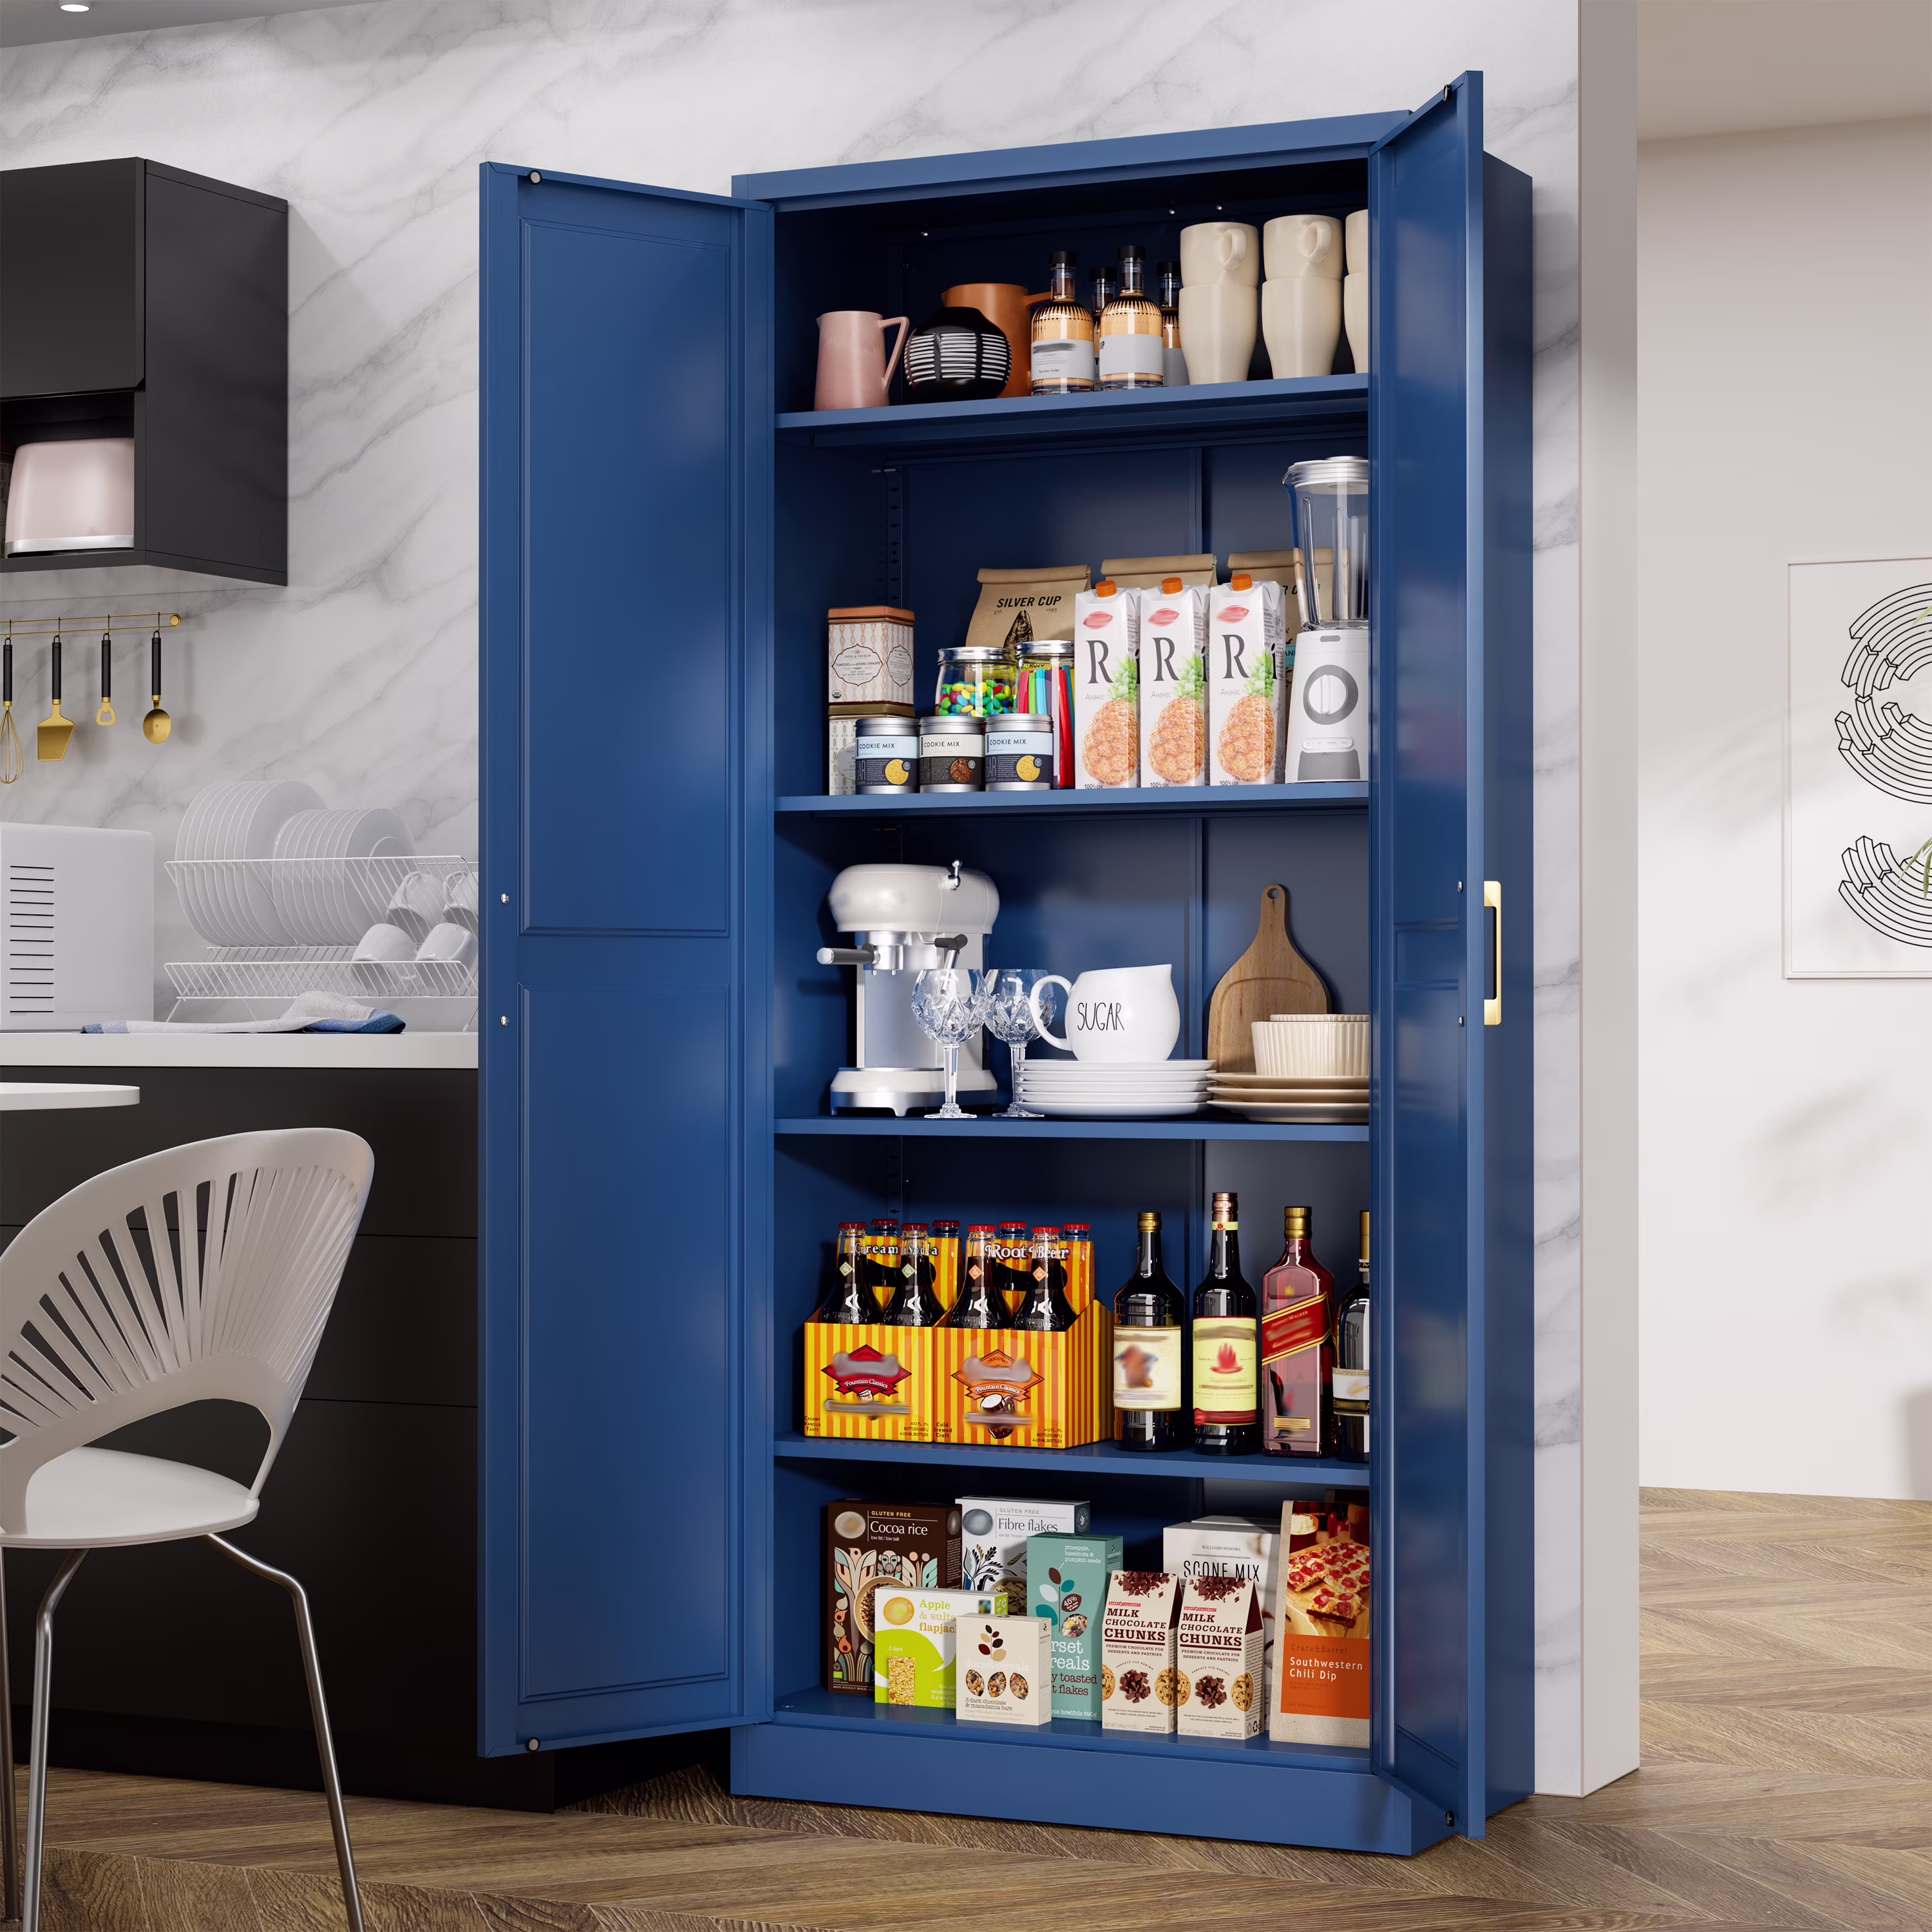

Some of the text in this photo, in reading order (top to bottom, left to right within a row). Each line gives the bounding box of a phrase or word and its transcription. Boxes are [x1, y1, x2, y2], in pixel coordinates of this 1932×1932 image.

[997, 596, 1061, 608] SILVER CUP
[1077, 1002, 1124, 1030] SUGAR
[984, 1244, 1027, 1260] Root
[1288, 1311, 1309, 1320] WALKER
[869, 1379, 888, 1388] Classics
[999, 1385, 1020, 1394] Classics
[871, 1521, 928, 1535] Cocoa rice
[999, 1518, 1058, 1533] Fibre flakes
[1235, 1564, 1260, 1582] MIX
[919, 1599, 951, 1611] Apple
[1064, 1595, 1077, 1607] 45%
[1106, 1608, 1140, 1618] MILK
[1182, 1613, 1215, 1623] MILK
[1105, 1619, 1166, 1629] CHOCOLATE
[1180, 1624, 1243, 1634] CHOCOLATE
[1104, 1628, 1166, 1641] CHUNKS
[1180, 1633, 1242, 1646] CHUNKS
[1291, 1643, 1347, 1654] Crate&Barrel
[965, 1659, 994, 1669] dorset
[1141, 1662, 1154, 1671] BAKING
[1291, 1656, 1363, 1671] Southwestern
[1217, 1667, 1230, 1676] BAKING
[1289, 1669, 1337, 1682] Chili Dip
[1060, 1672, 1097, 1684] toasted
[1059, 1685, 1088, 1695] flakes
